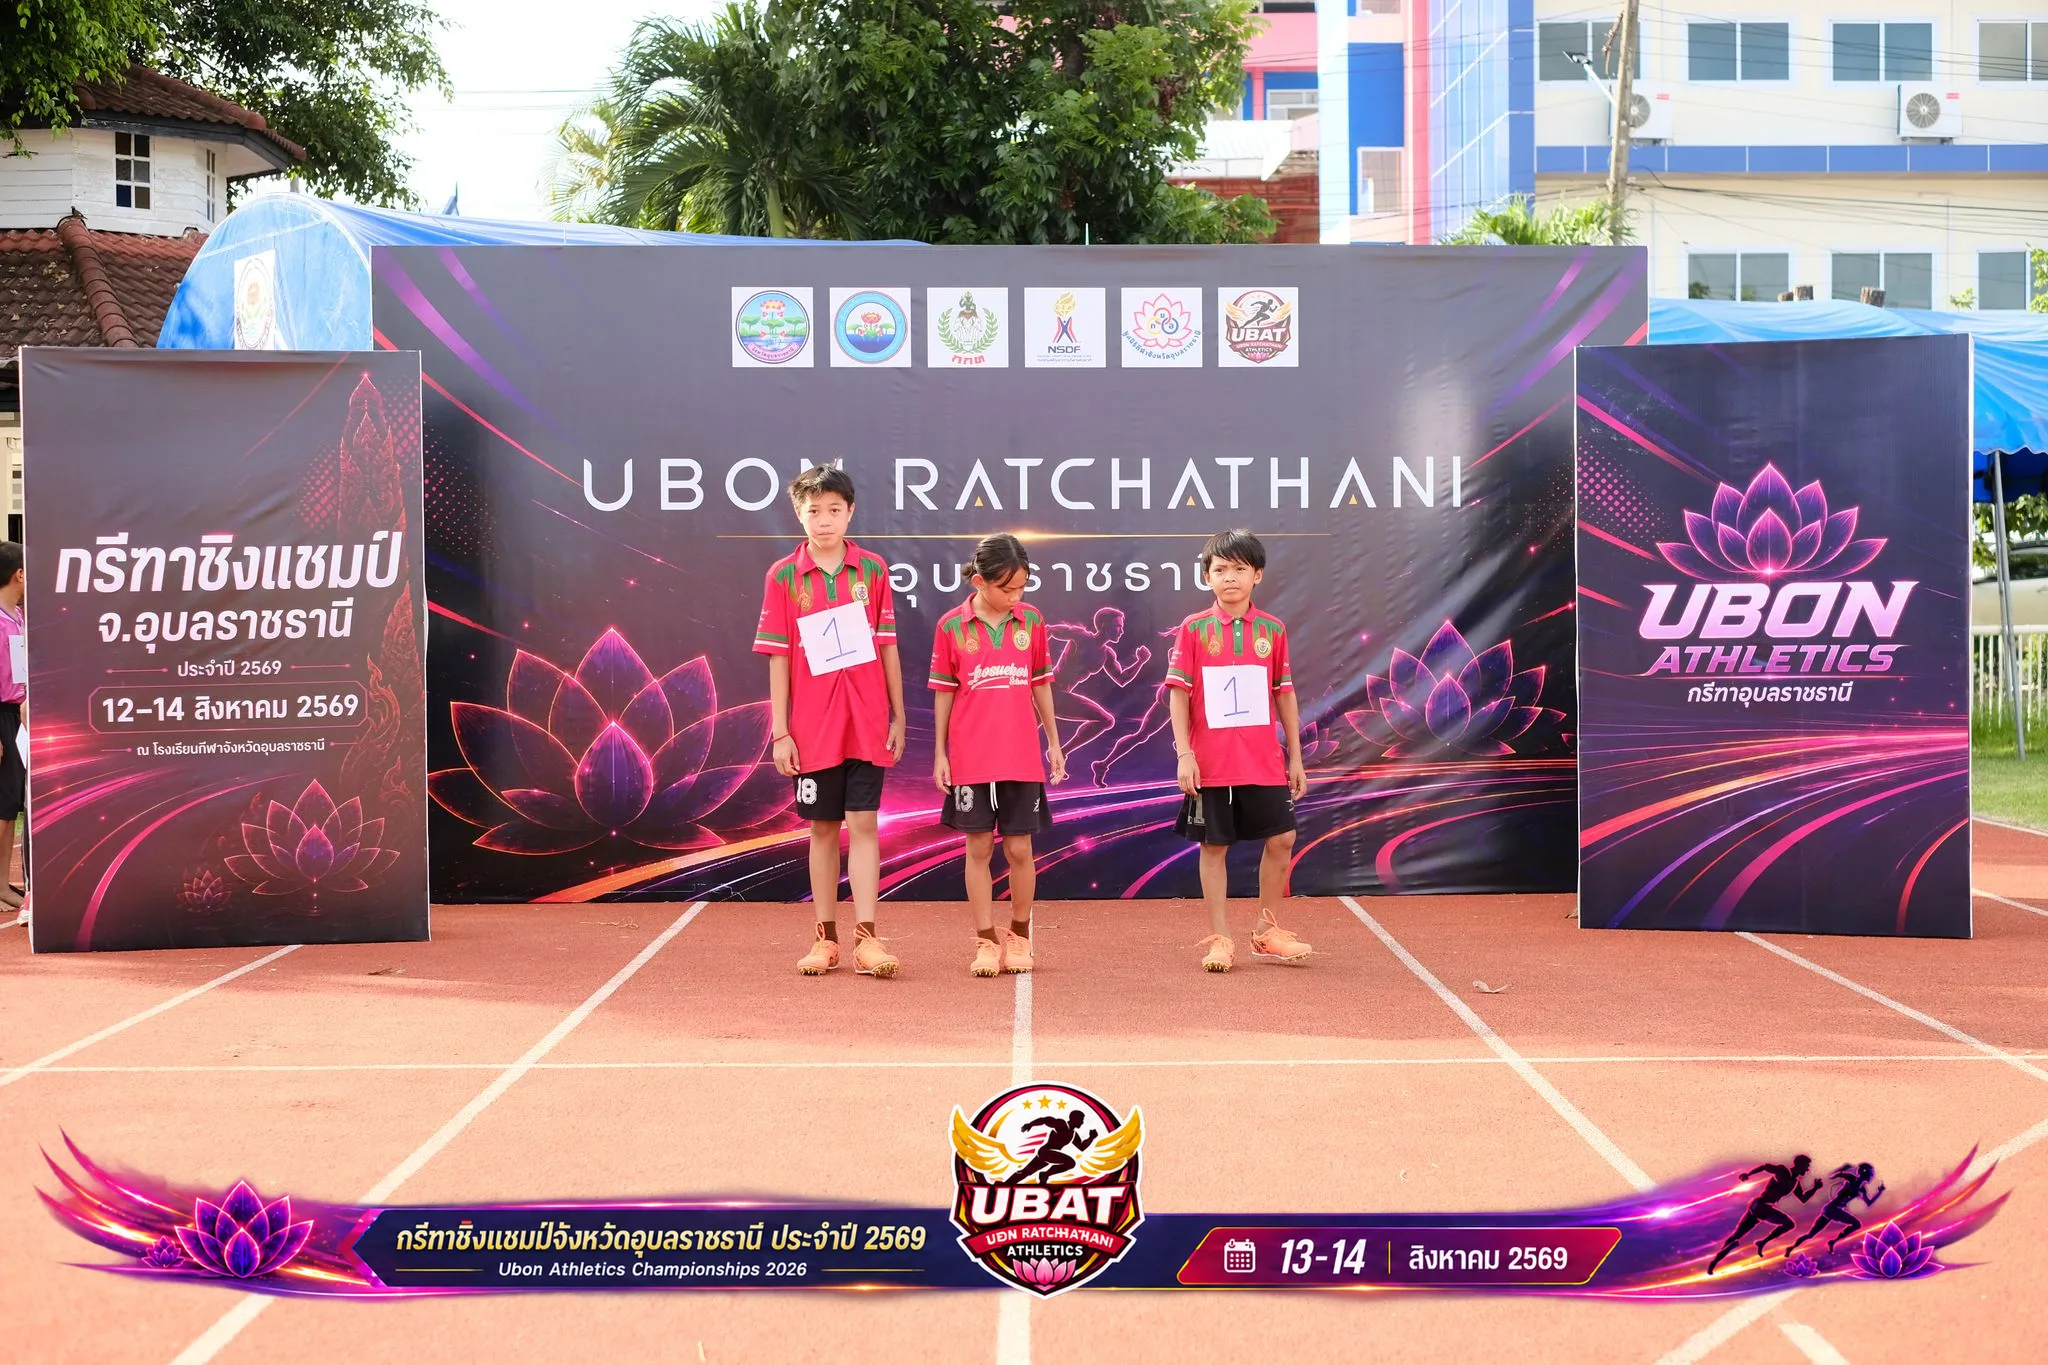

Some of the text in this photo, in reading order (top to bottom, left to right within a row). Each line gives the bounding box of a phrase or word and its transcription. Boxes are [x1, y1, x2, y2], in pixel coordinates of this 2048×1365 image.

[1047, 345, 1081, 354] NSDF
[1231, 328, 1286, 342] UBAT
[583, 456, 1461, 512] UBO RATCHATHANI
[55, 530, 403, 593] กรีฑาชิงแชมป์
[98, 596, 354, 654] จ.อุบลราชธานี
[1639, 580, 1920, 640] UBON
[822, 616, 858, 662] 1
[177, 659, 282, 677] ประจำปี 2569
[1641, 644, 1910, 676] ATHLETICS
[194, 695, 288, 721] สิงหาคม
[296, 694, 359, 718] 2569
[1223, 676, 1250, 717] 1
[1687, 681, 1854, 709] กรีฑาอุบลราชธานี
[136, 738, 325, 757] ณ โรงเรียนกีฬาจังหวัดอุบลราชธานี
[955, 785, 975, 813] 13
